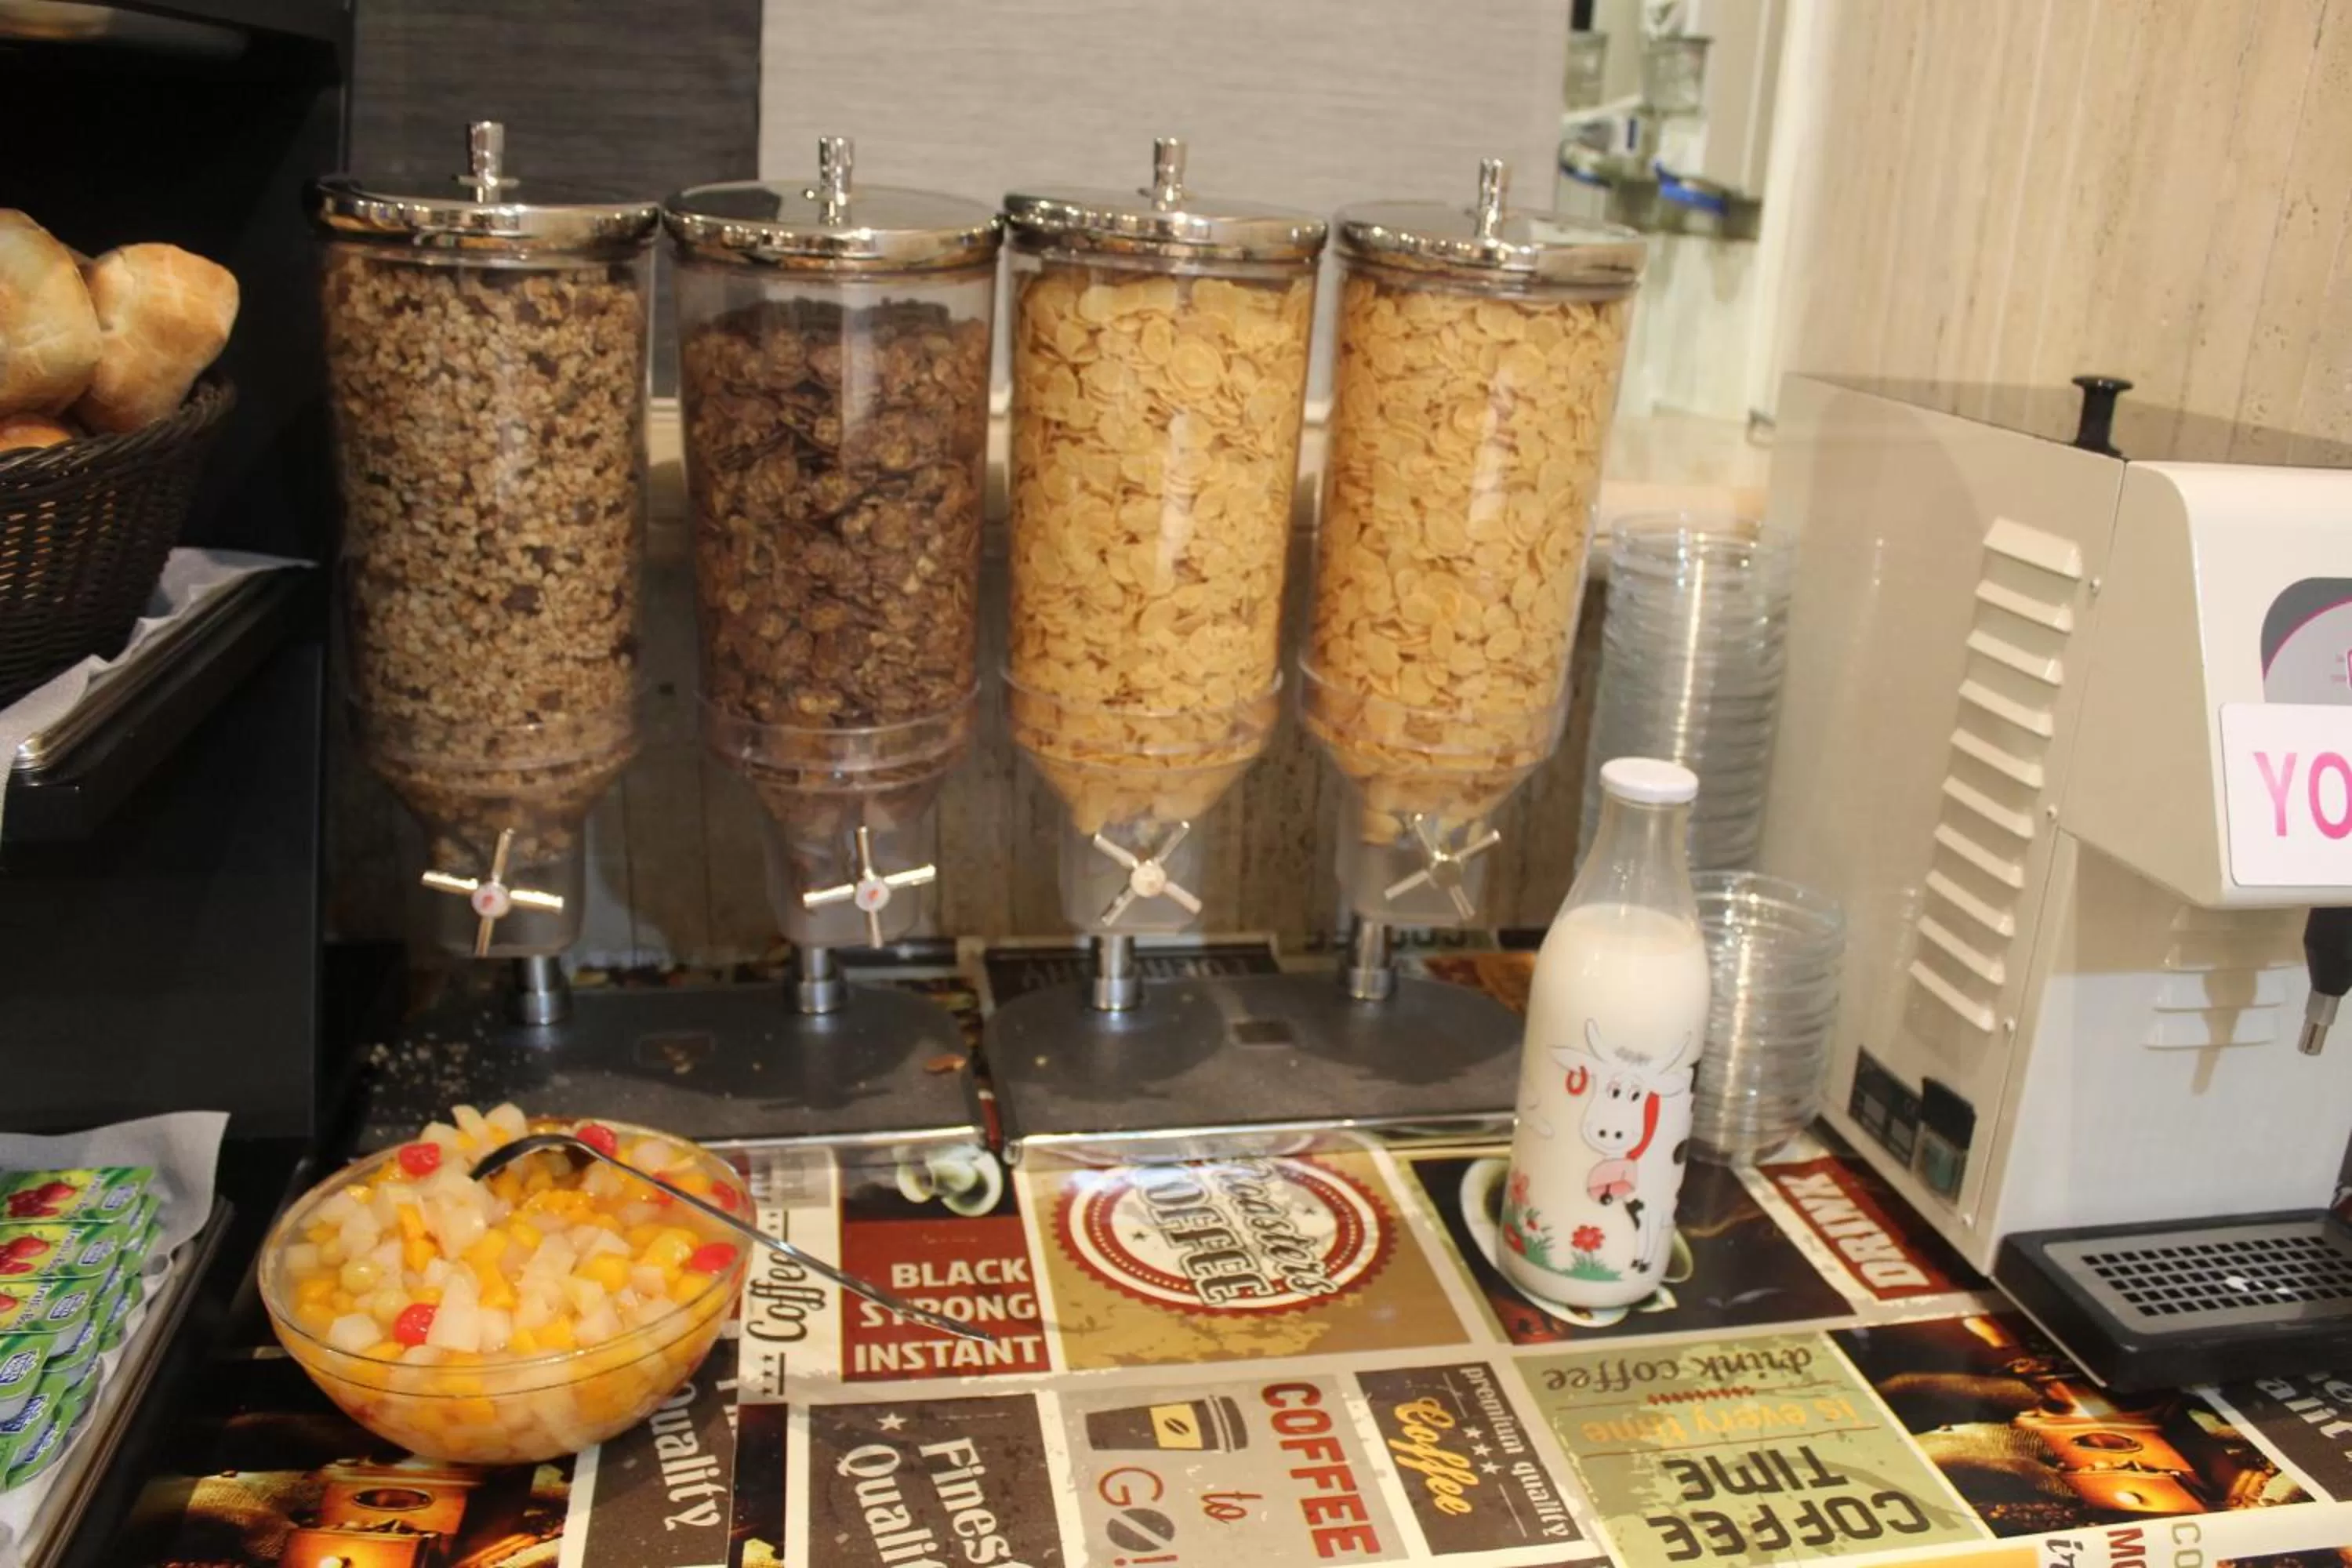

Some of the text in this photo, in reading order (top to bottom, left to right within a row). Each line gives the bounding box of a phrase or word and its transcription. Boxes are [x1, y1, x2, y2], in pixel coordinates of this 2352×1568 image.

[1136, 1168, 1276, 1305] OFFEE
[1777, 1172, 1930, 1289] DRINK
[891, 1258, 1029, 1289] BLACK
[855, 1336, 1041, 1373] INSTANT
[1541, 1346, 1813, 1394] drink coffee
[1694, 1402, 1806, 1436] every
[1261, 1382, 1381, 1558] COFFEE
[1388, 1396, 1479, 1515] Coffee
[1459, 1367, 1570, 1537] premium quality
[1661, 1446, 1849, 1501] TIME
[1200, 1490, 1264, 1524] to
[1647, 1490, 1931, 1562] COFFEE
